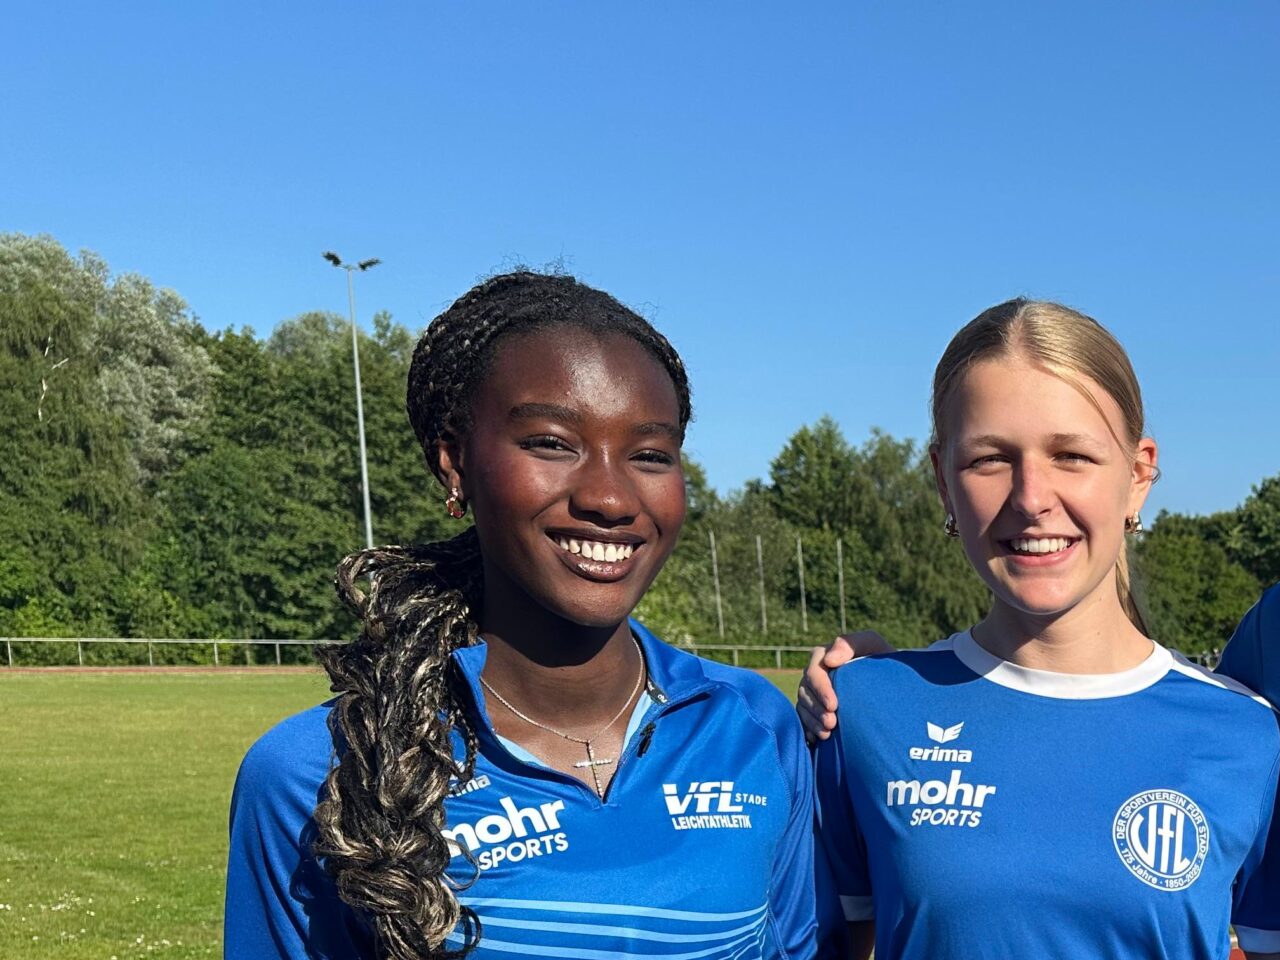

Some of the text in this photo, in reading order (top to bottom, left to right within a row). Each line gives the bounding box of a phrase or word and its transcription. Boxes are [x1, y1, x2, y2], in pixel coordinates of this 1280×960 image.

[909, 746, 973, 763] erima
[662, 781, 767, 814] VfL STADE
[887, 770, 996, 808] mohr
[671, 813, 752, 831] LEICHTATHLETIK
[910, 808, 982, 828] SPORTS
[1116, 792, 1207, 860] DER SPORTVEREIN FÜR STADE
[478, 832, 569, 870] SPORTS
[1121, 848, 1158, 884] 175 Jahre
